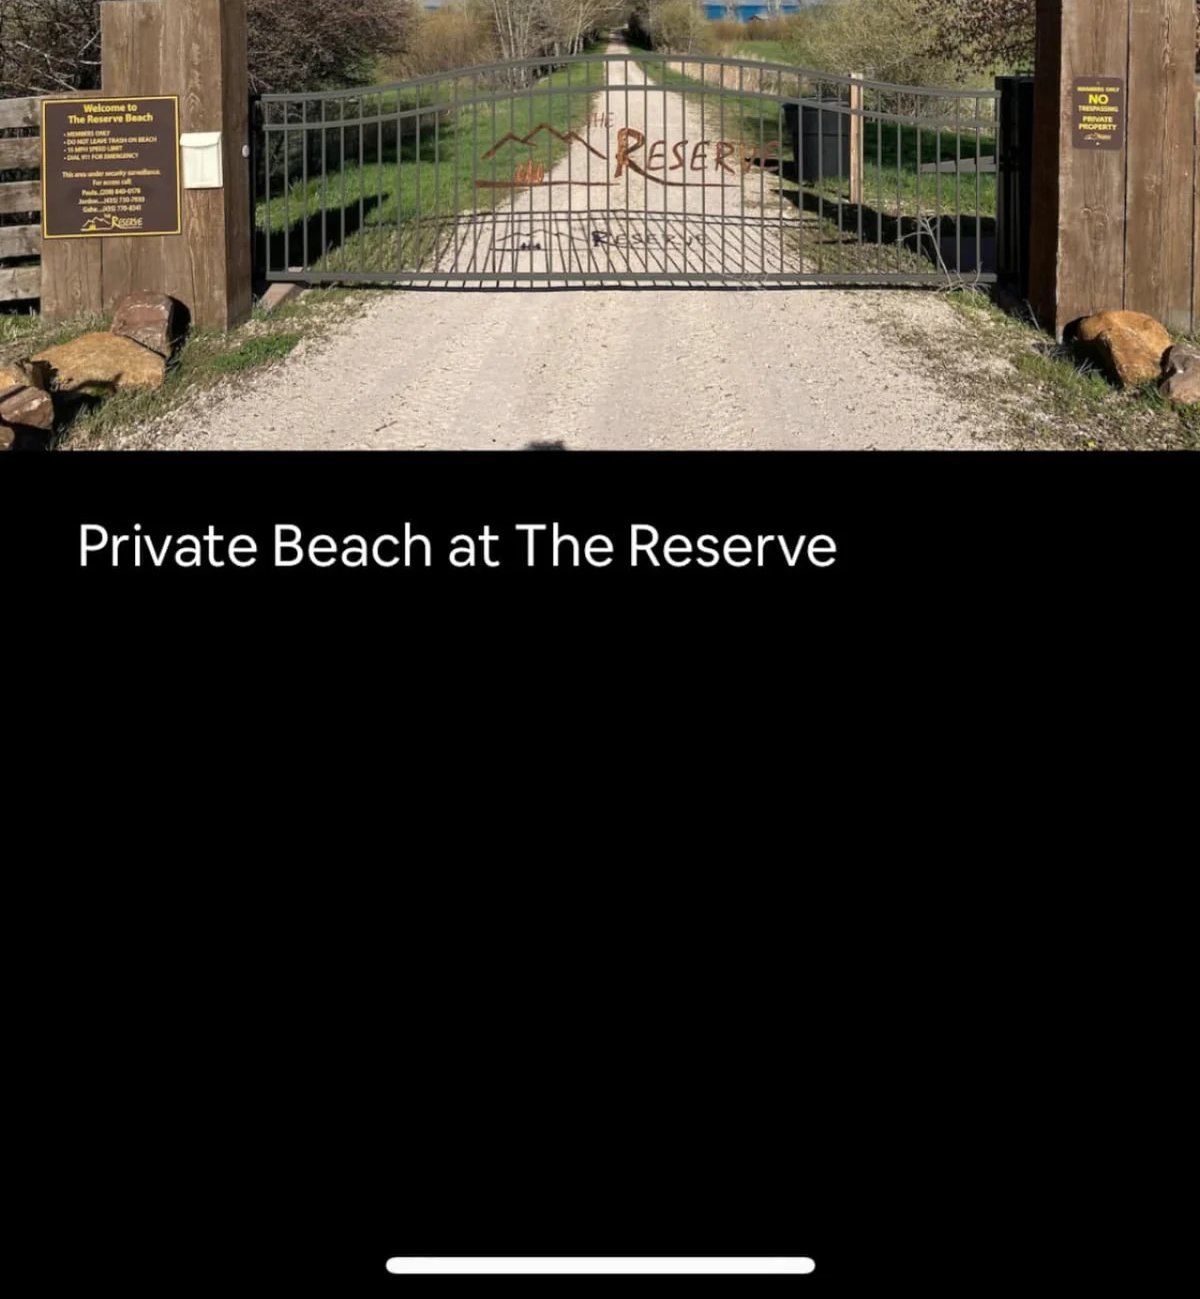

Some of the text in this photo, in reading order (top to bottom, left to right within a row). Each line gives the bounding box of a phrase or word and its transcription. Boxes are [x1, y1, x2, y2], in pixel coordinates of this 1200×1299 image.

[1088, 94, 1109, 105] NO
[83, 103, 138, 113] Welcome to
[68, 112, 153, 124] The Reserve Beach
[614, 127, 780, 178] RESERVE
[62, 171, 74, 179] This
[105, 169, 127, 177] security
[111, 215, 143, 228] RESERVE
